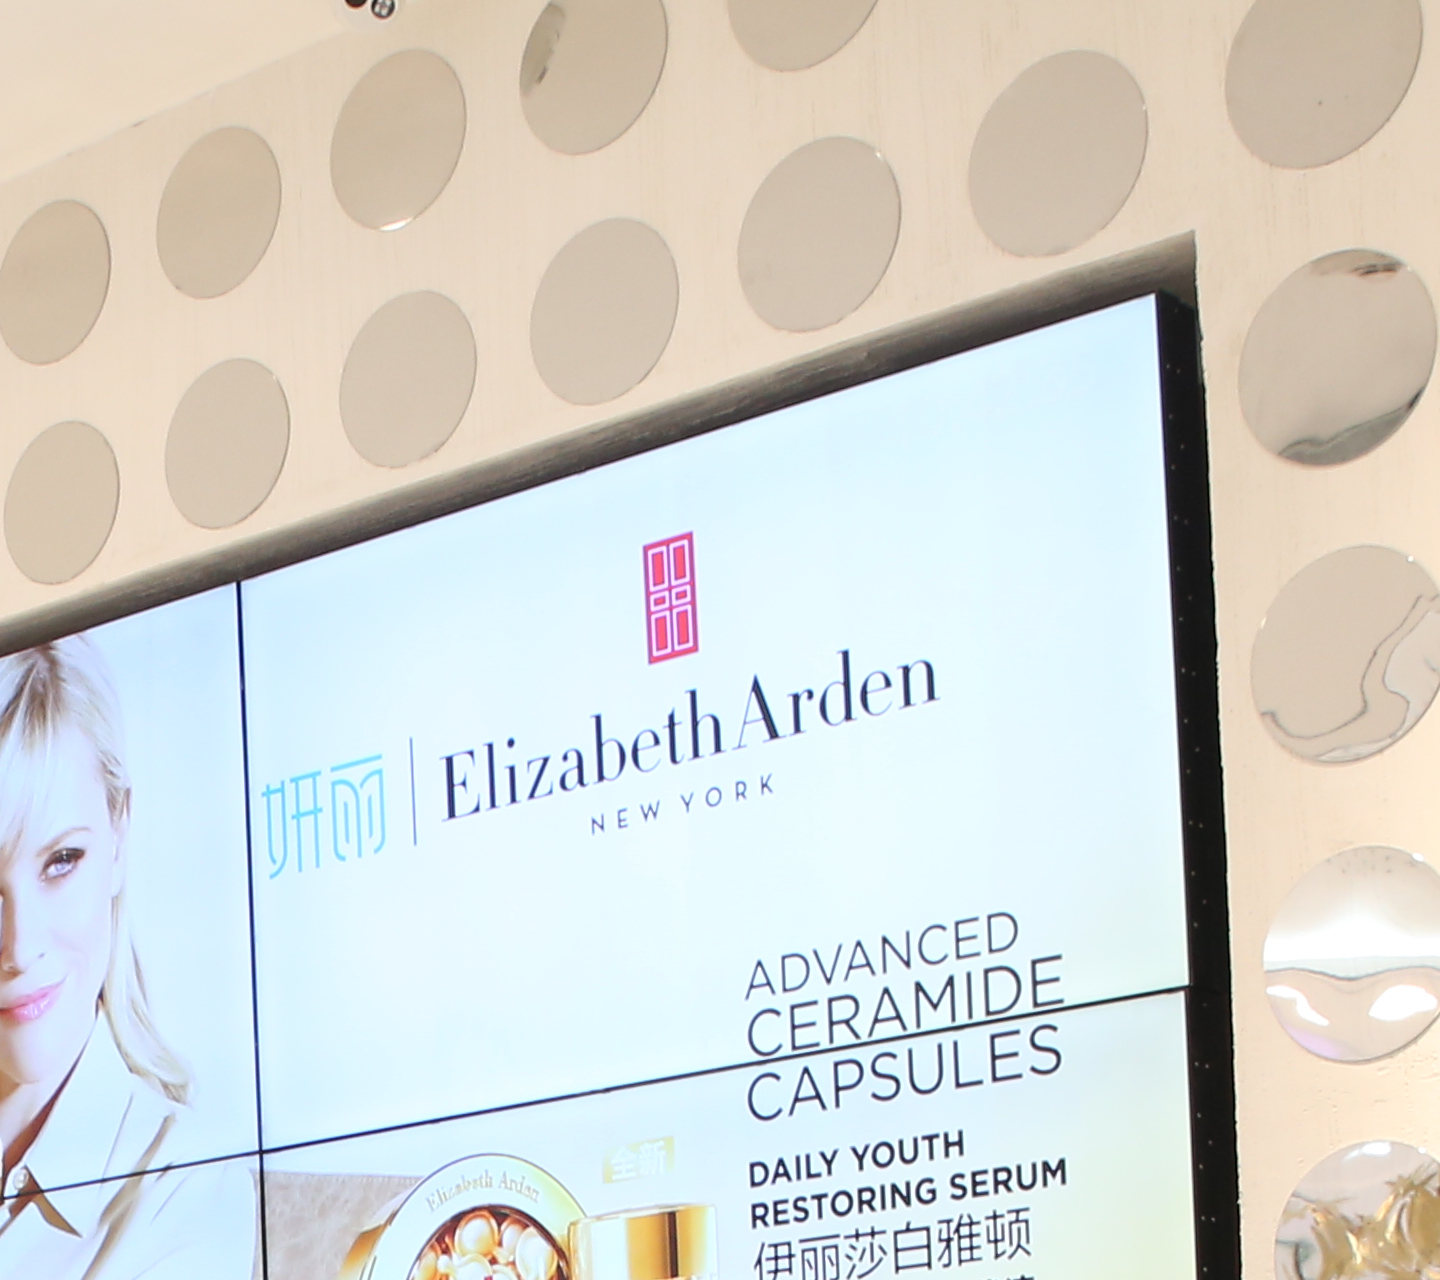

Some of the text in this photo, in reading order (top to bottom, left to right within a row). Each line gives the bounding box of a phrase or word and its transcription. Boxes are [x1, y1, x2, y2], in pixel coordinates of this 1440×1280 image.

[441, 649, 941, 823] Elizabeth Arden
[261, 754, 384, 880] 妍丽
[591, 774, 775, 835] NEW YORK
[744, 911, 1019, 1001] ADVANCED
[747, 953, 1065, 1057] CERAMIDE
[747, 1023, 1063, 1122] CAPSULES
[748, 1129, 965, 1188] DAILY YOUTH
[751, 1157, 1068, 1229] RESTORING SERUM
